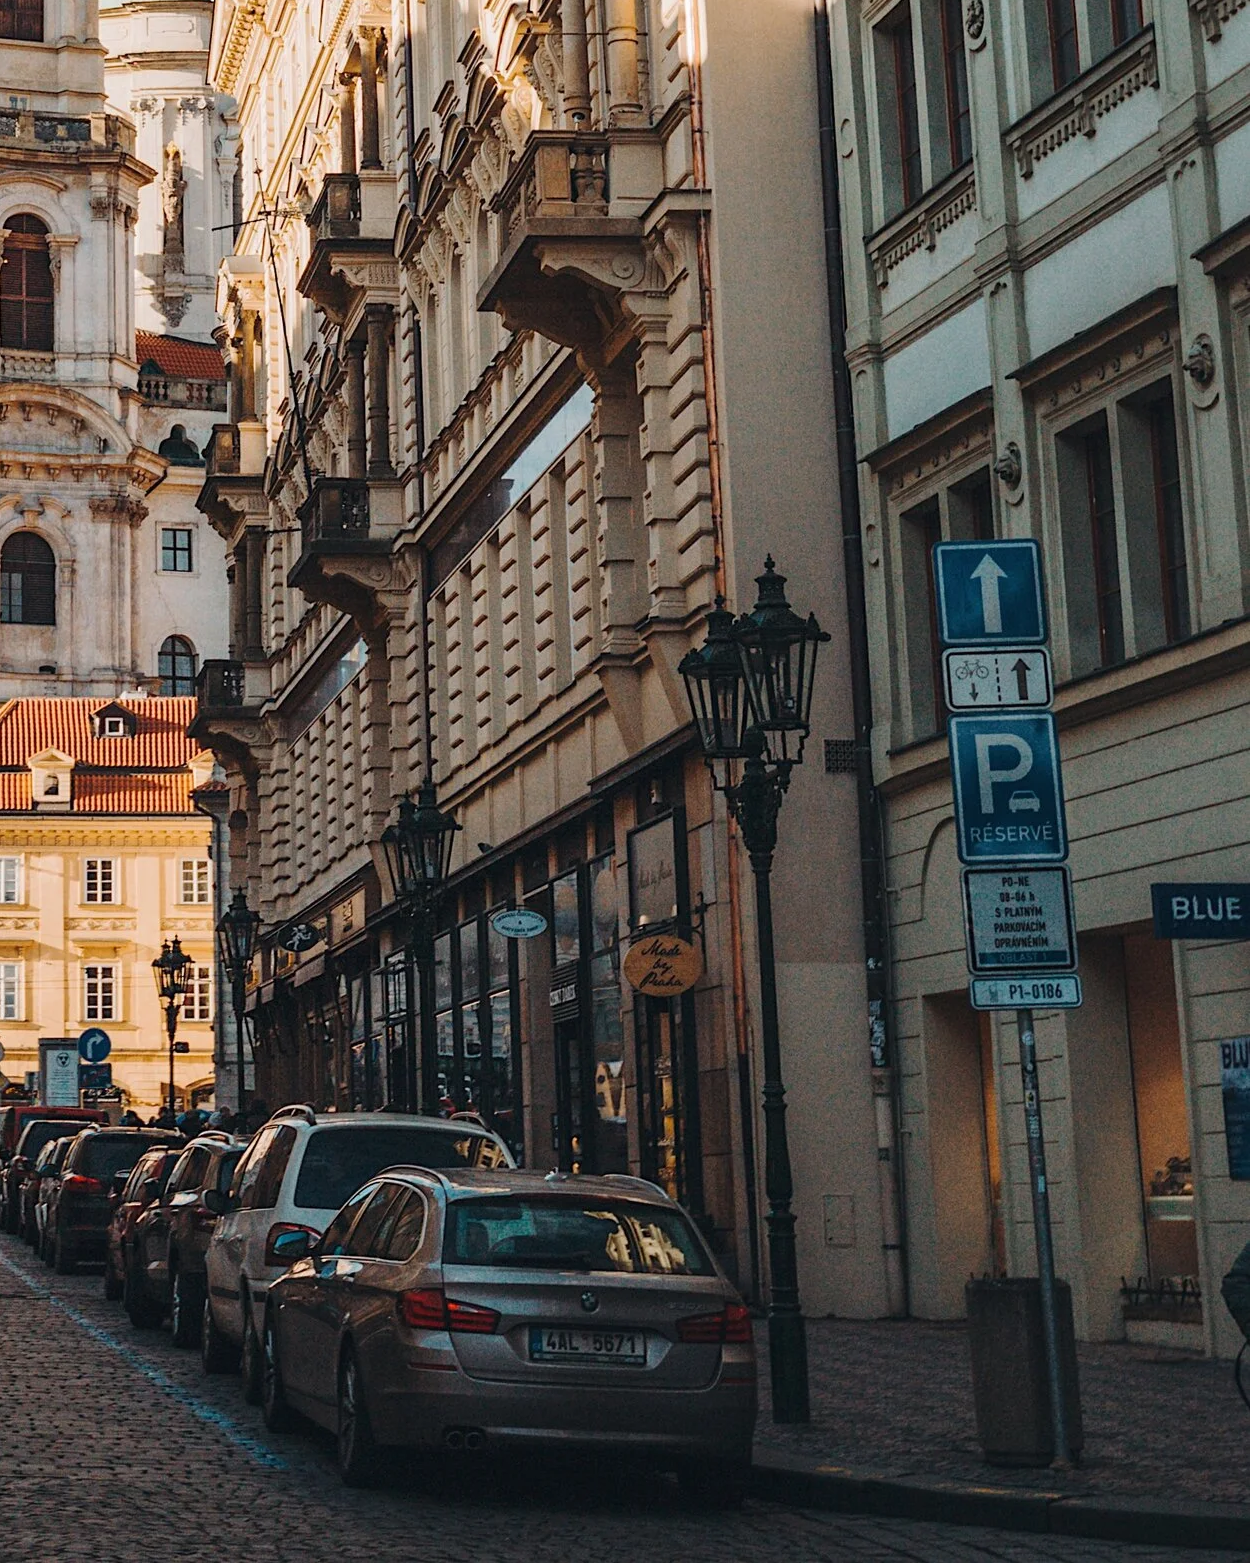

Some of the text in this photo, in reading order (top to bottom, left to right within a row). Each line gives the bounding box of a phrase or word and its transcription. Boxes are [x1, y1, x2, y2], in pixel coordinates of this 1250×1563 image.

[974, 733, 1033, 814] P
[970, 821, 1053, 843] RÉSERVÉ
[1002, 876, 1029, 887] PO-NE
[999, 892, 1035, 902] 08-06 h
[995, 905, 1043, 918] S PLATNÝM
[1171, 895, 1242, 921] BLUE
[994, 919, 1046, 933] PARKOVACÍM
[641, 939, 681, 956] Made
[994, 937, 1048, 948] OPRÁVNĚNÍM
[1000, 953, 1038, 962] OBLAST
[653, 958, 672, 976] by
[639, 971, 683, 988] Praha
[1009, 983, 1063, 999] P1-0186
[1222, 1040, 1249, 1069] BLU
[546, 1332, 636, 1353] 4AL 5671
